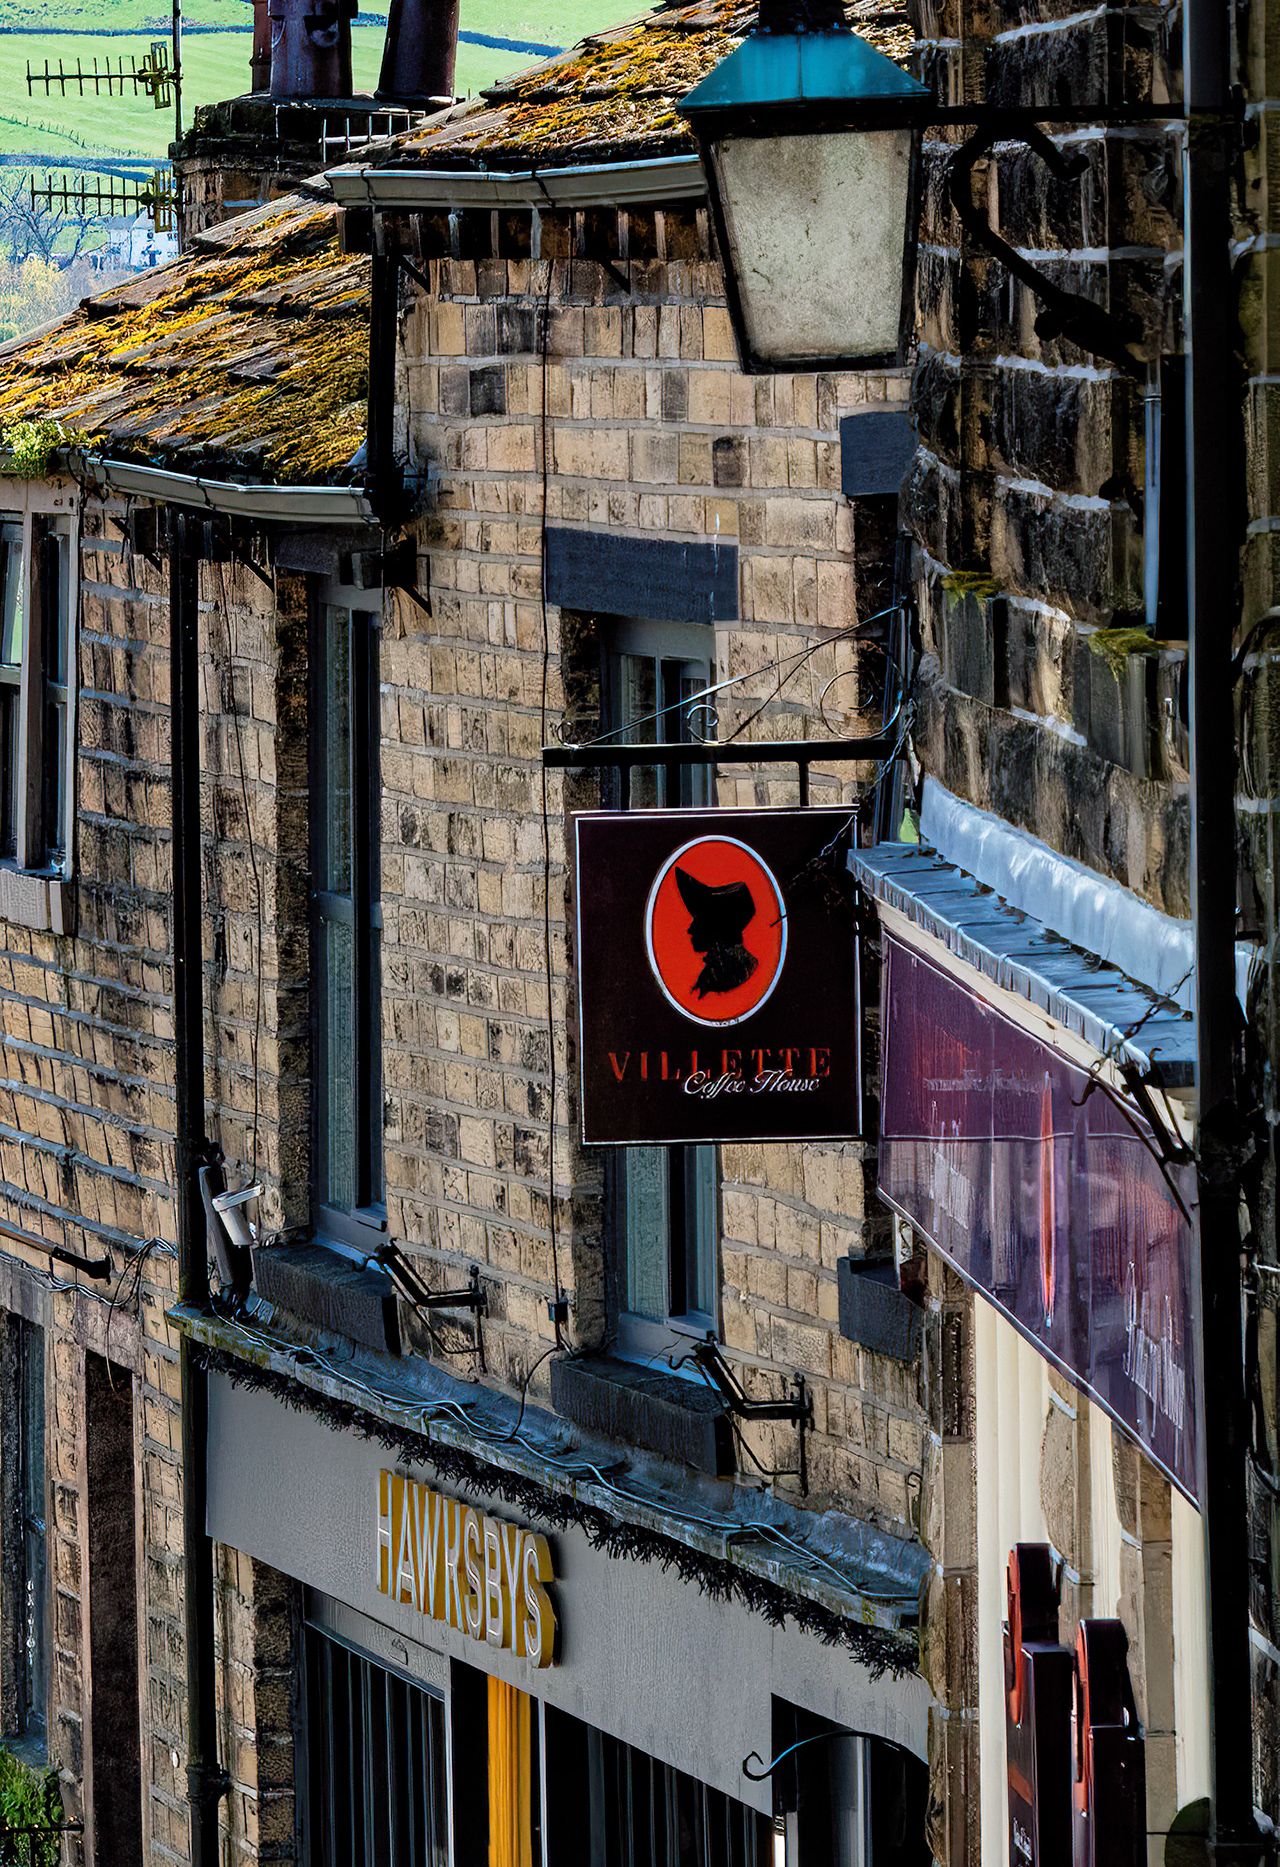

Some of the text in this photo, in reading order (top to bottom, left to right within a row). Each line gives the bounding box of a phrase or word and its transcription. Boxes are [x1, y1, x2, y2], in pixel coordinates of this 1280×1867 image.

[608, 1048, 831, 1083] VILLETTE
[684, 1068, 820, 1099] Coffee House
[377, 1468, 559, 1669] HAWKSBYS
